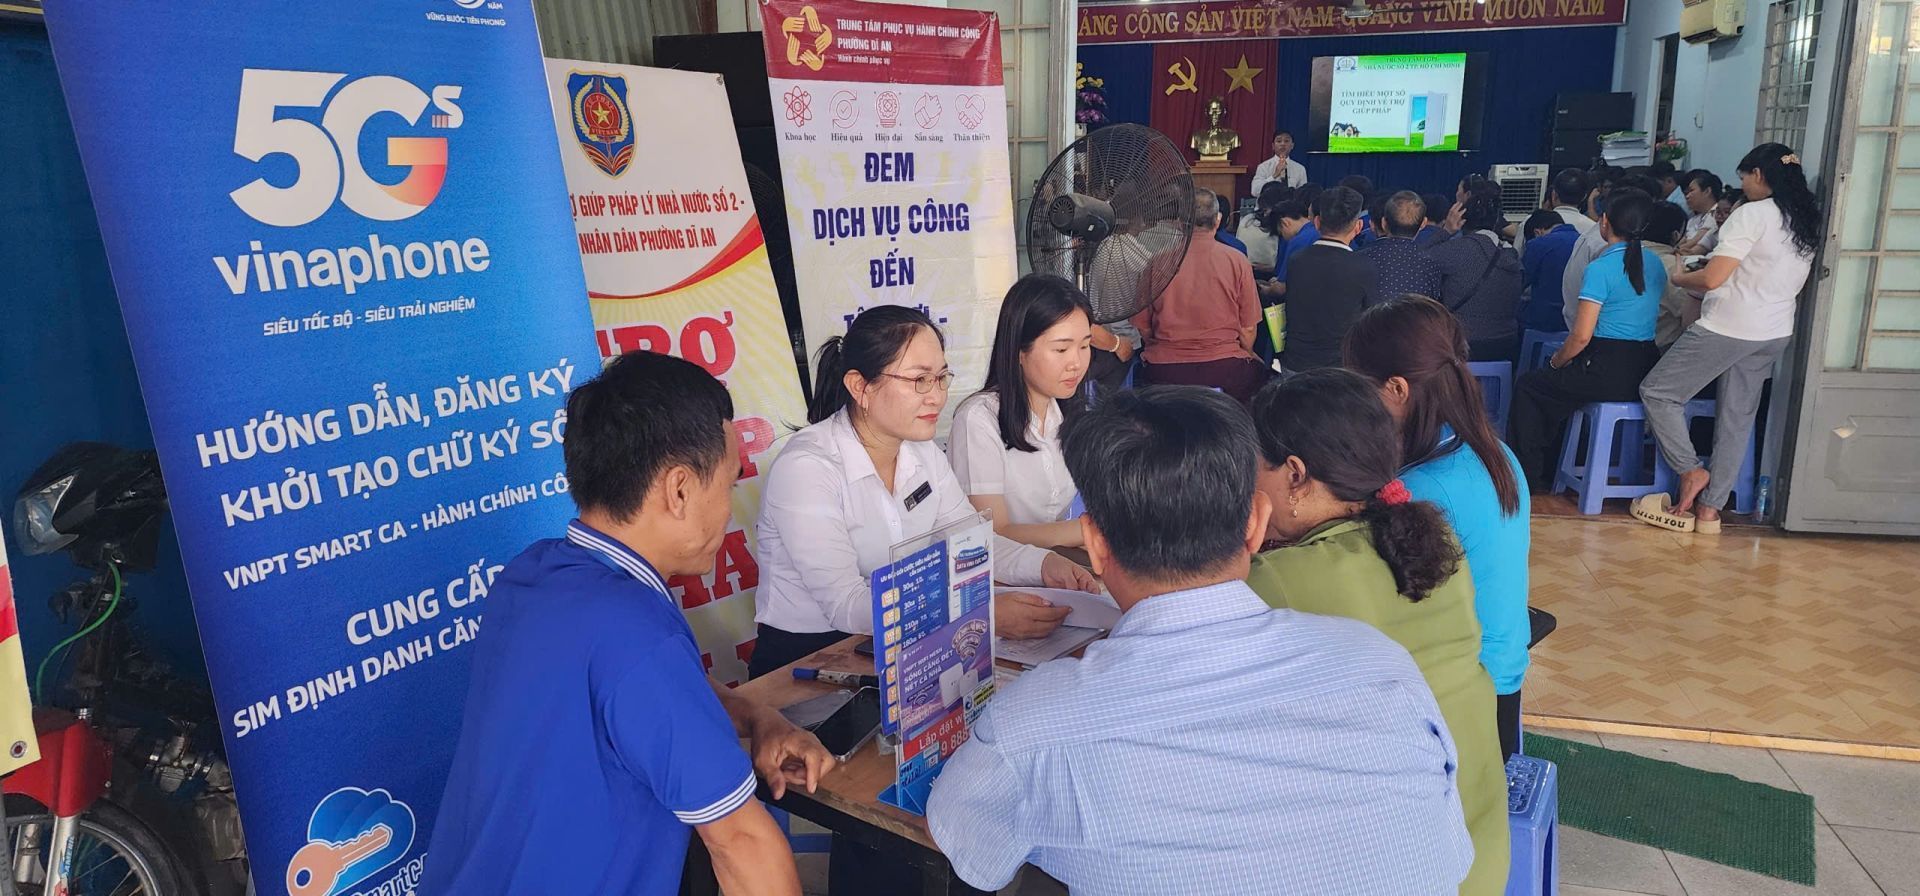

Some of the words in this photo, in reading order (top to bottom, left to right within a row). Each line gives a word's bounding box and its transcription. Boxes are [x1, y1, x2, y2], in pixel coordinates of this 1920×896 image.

[480, 18, 506, 26] PHONG
[837, 19, 862, 31] TRUNG
[864, 19, 881, 33] TÂM
[883, 22, 903, 37] PHỤC
[905, 24, 914, 37] VỤ
[916, 23, 936, 37] HÀNH
[937, 25, 959, 38] CHÍNH
[960, 26, 981, 39] CÔNG
[1078, 8, 1118, 36] ẢNG
[1124, 7, 1180, 39] CỘNG
[1184, 3, 1225, 32] SẢN
[1230, 3, 1280, 36] VIỆT
[1287, 5, 1335, 28] NAM
[1420, 0, 1476, 23] VINH
[838, 36, 869, 50] PHƯỜNG
[880, 40, 892, 52] AN
[785, 132, 802, 141] Khoa
[803, 132, 816, 142] học
[831, 133, 848, 142] Hiệu
[850, 132, 863, 143] quả
[864, 152, 914, 182] ĐEM
[579, 191, 606, 217] GIÚP
[609, 190, 639, 217] PHÁP
[641, 190, 654, 215] LÝ
[655, 189, 681, 214] NHÀ
[681, 189, 712, 213] NƯỚC
[712, 186, 729, 212] SỐ
[729, 192, 739, 211] 2
[578, 228, 613, 255] NHÂN
[614, 227, 639, 252] DÂN
[639, 224, 685, 251] PHƯỜNG
[685, 225, 699, 248] DĨ
[700, 227, 717, 248] AN
[813, 206, 866, 246] DỊCH
[872, 205, 900, 242] VỤ
[908, 198, 970, 234] CÔNG
[213, 234, 490, 295] vinaphone
[869, 248, 914, 288] ĐẾN
[263, 316, 298, 336] SIÊU
[303, 310, 330, 331] TỐC
[332, 309, 353, 329] ĐỘ
[365, 305, 395, 323] SIÊU
[398, 300, 426, 317] TRẢI
[429, 296, 475, 315] NGHIỆM
[196, 410, 341, 469] HƯỚNG
[348, 382, 430, 435] DẪN,
[434, 375, 521, 419] ĐĂNG
[528, 358, 575, 397] KÝ
[220, 466, 321, 527] KHỞI
[327, 455, 398, 500] TẠO
[407, 431, 473, 479] CHỮ
[480, 416, 521, 461] KÝ
[223, 553, 289, 590] VNPT
[294, 529, 373, 569] SMART
[378, 520, 407, 544] CA
[421, 504, 476, 531] HÀNH
[479, 485, 537, 513] CHÍNH
[540, 472, 571, 496] CÔ
[346, 588, 440, 645] CUNG
[232, 696, 282, 738] SIM
[287, 665, 356, 710] ĐỊNH
[362, 635, 433, 683] DANH
[904, 668, 922, 684] SÓNG
[919, 731, 937, 750] Lắp
[940, 721, 953, 737] đặt
[350, 853, 427, 896] artC
